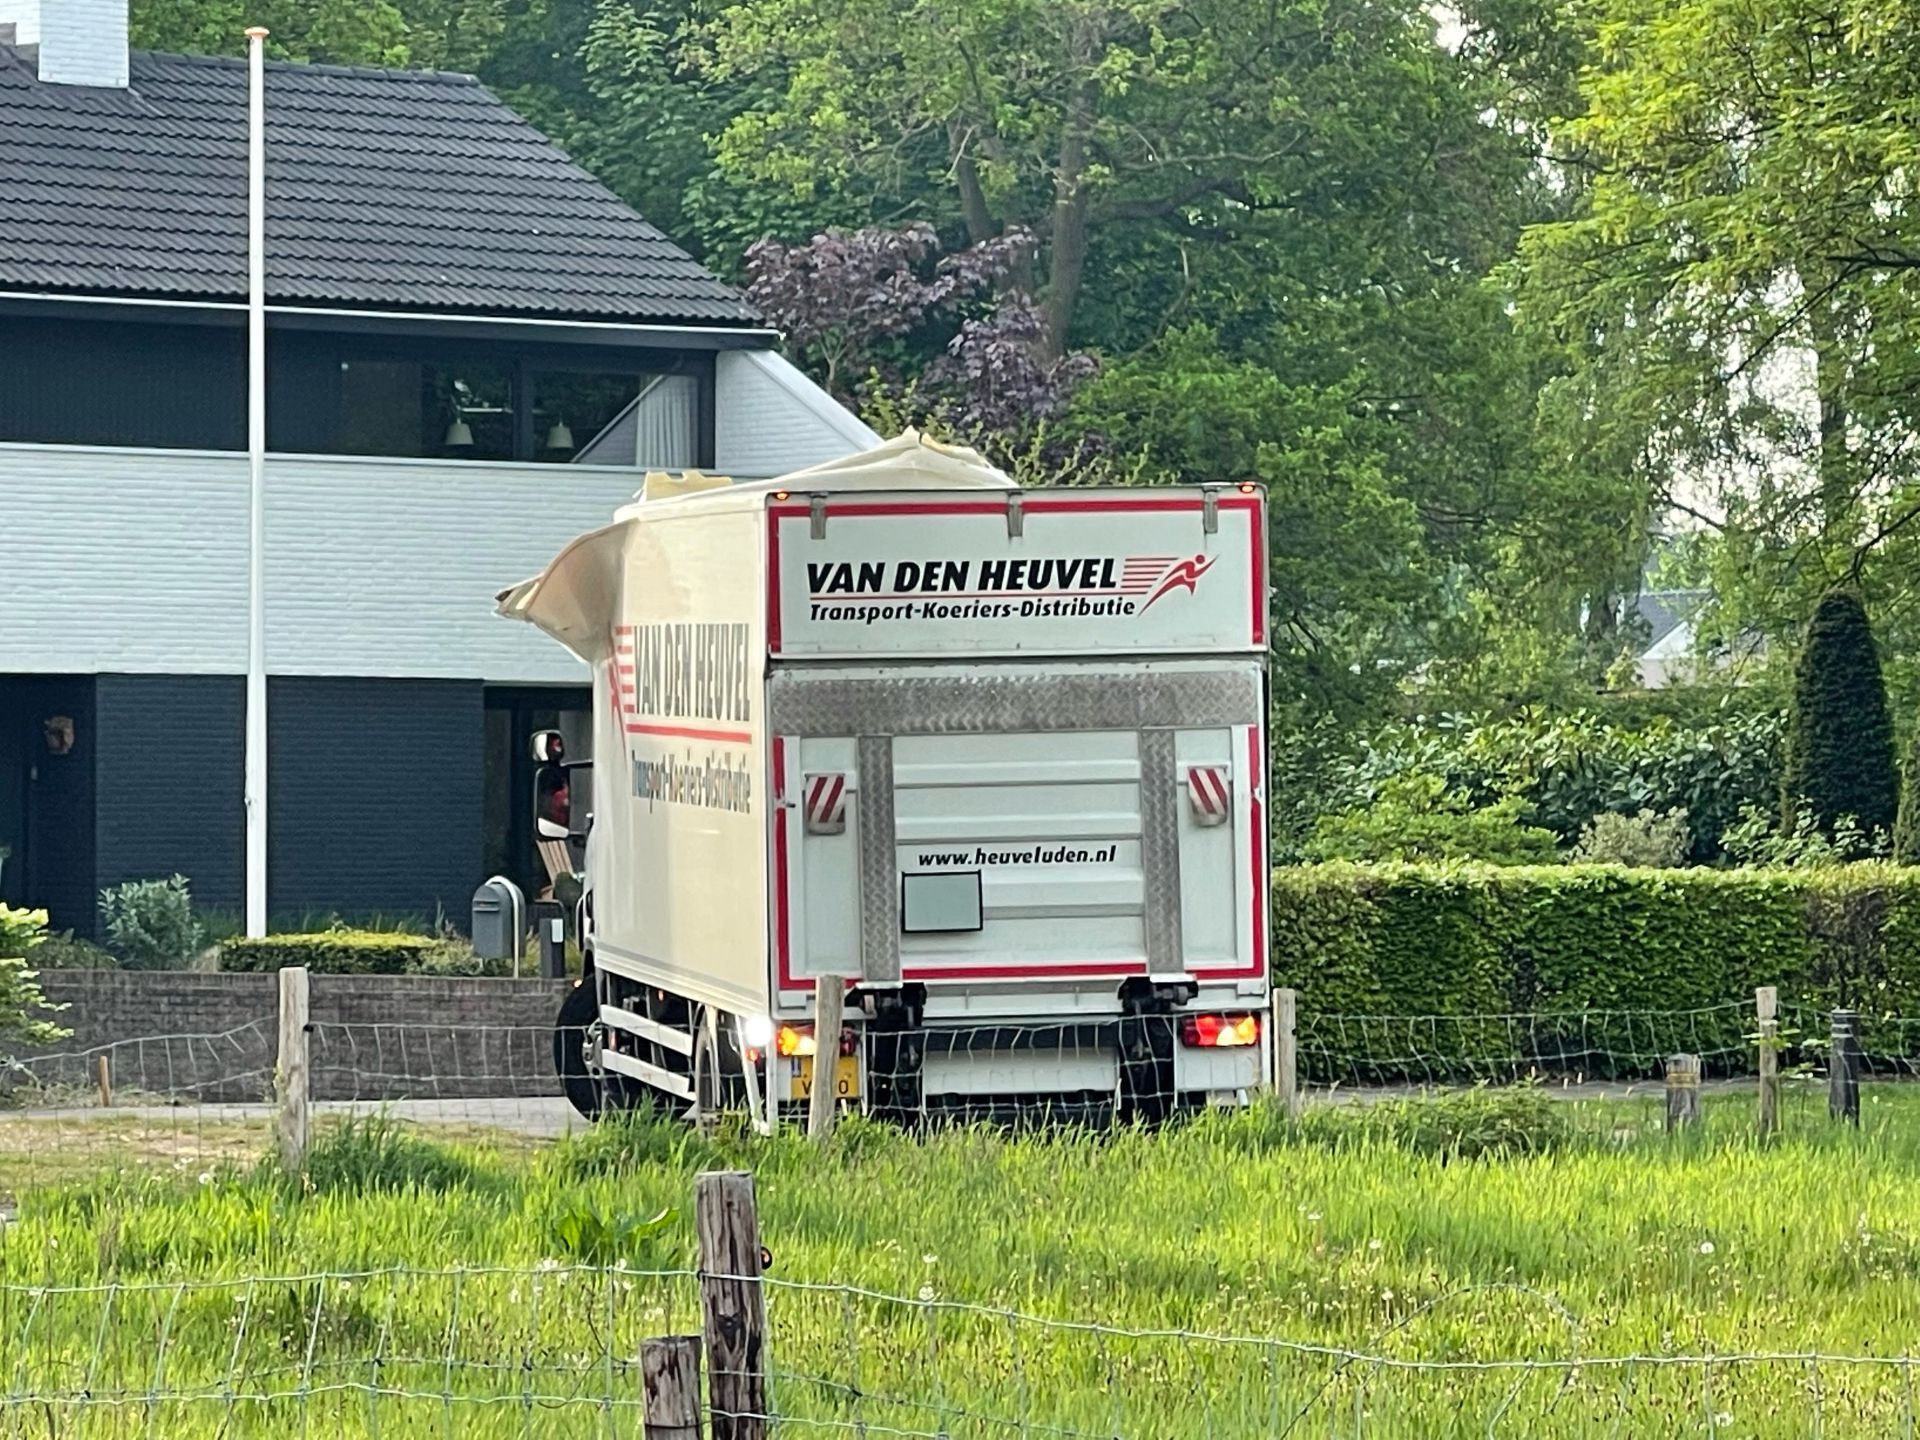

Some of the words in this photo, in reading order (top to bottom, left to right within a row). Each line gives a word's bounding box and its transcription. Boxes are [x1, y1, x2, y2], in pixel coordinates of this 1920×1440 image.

[807, 562, 885, 593] VAN
[893, 560, 969, 592] DEN
[978, 558, 1116, 591] HEUVEL
[810, 597, 1135, 625] Transport-Koeriers-Distributie
[634, 624, 661, 715] VAN
[665, 623, 691, 717] DEN
[696, 623, 750, 721] HEUVEL
[918, 845, 1116, 866] www.heuveluden.nl
